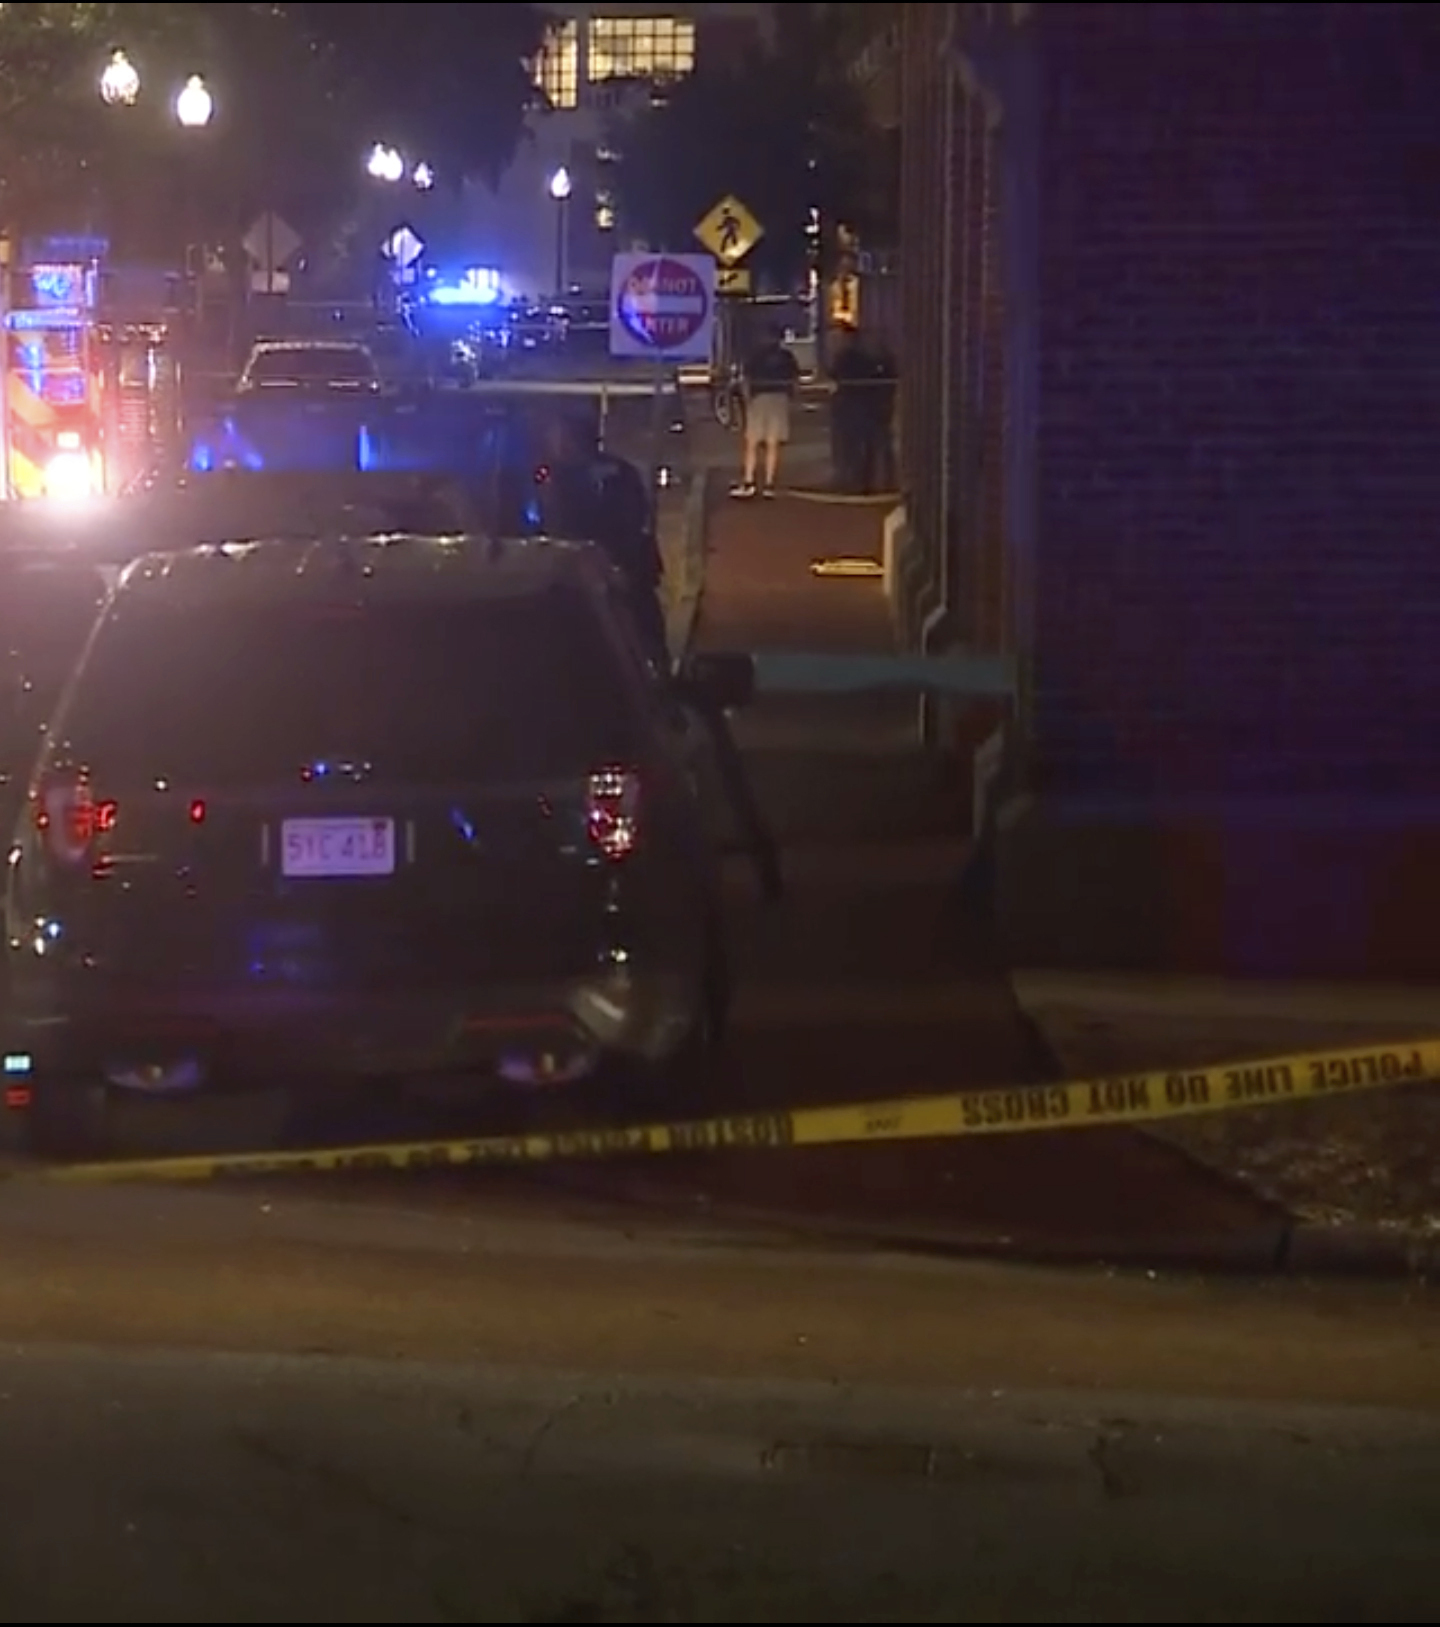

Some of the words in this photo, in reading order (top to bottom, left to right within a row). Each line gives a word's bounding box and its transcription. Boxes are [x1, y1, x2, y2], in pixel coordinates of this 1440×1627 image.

[662, 277, 696, 294] NOT
[1224, 1063, 1296, 1101] LINE
[1308, 1049, 1424, 1089] POLICE
[962, 1088, 1071, 1127] CROSS
[1087, 1078, 1153, 1115] NOT
[1164, 1073, 1212, 1106] DO
